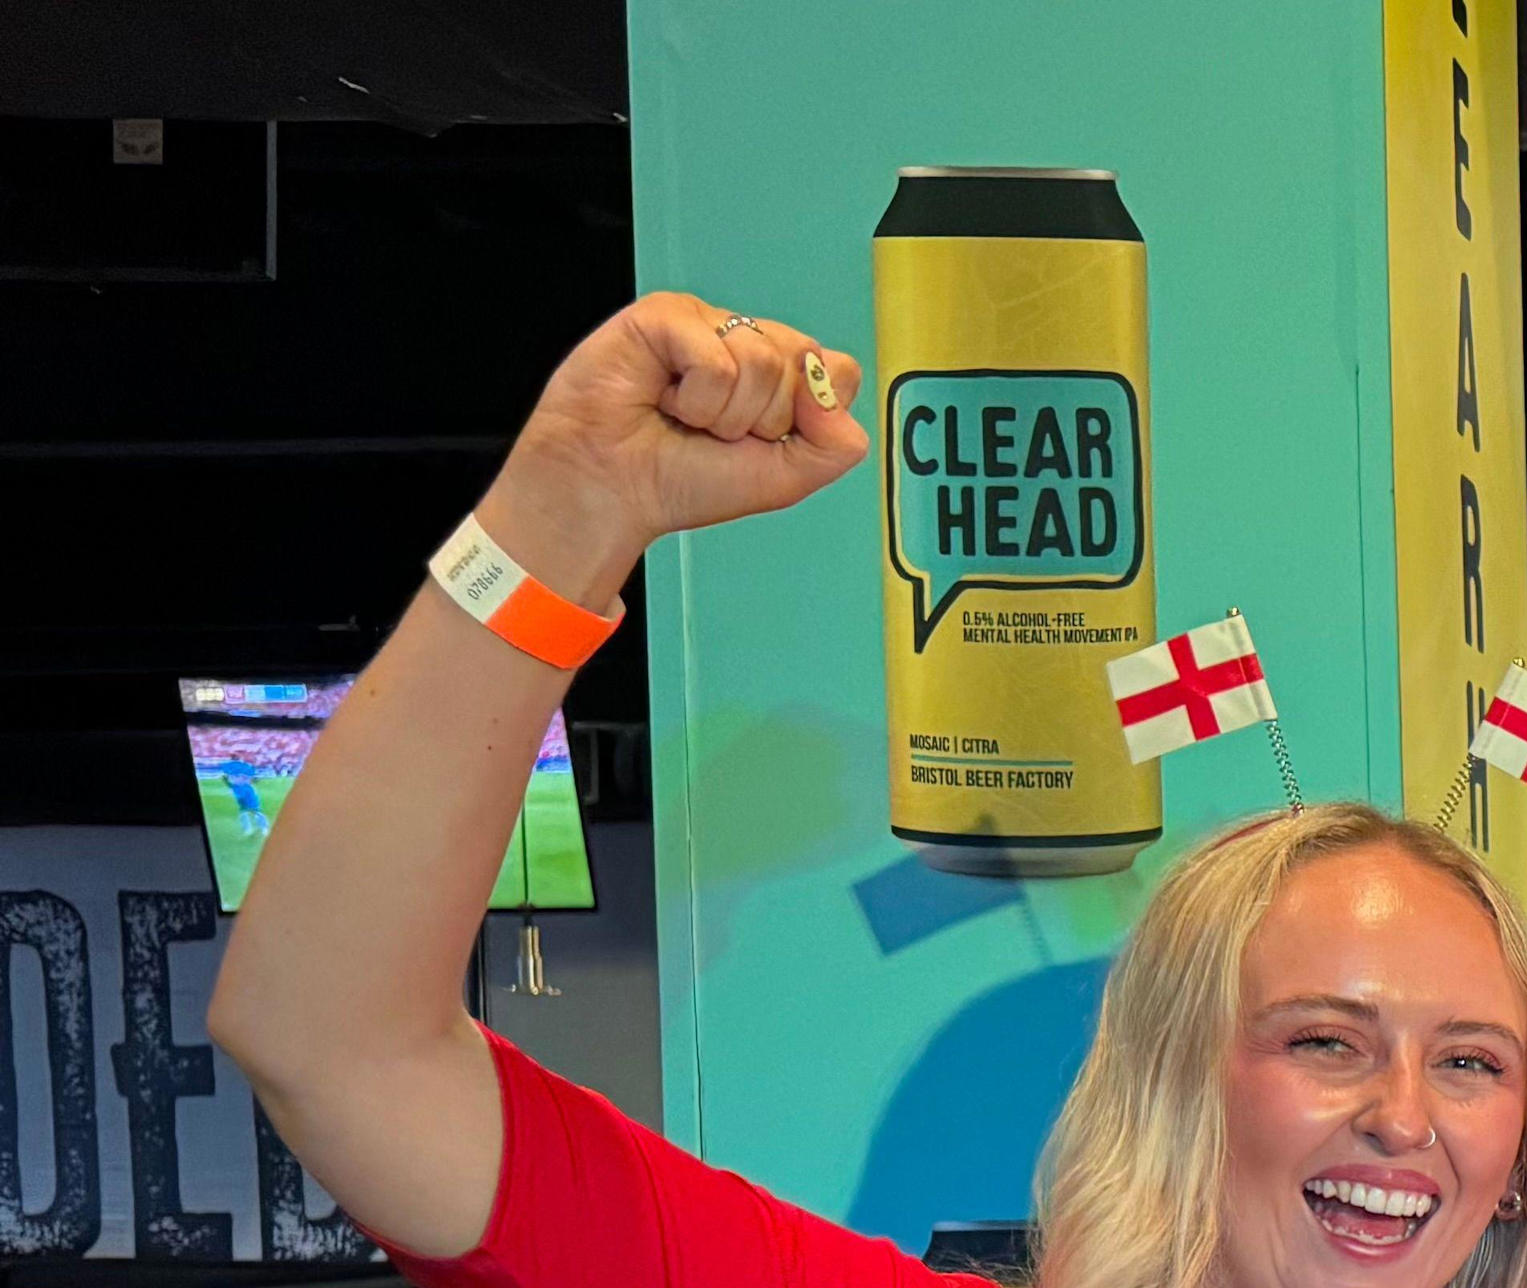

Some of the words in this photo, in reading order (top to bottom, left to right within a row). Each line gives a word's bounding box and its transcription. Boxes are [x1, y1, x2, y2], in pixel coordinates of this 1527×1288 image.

[903, 405, 1113, 479] CLEAR
[937, 485, 1118, 557] HEAD
[963, 610, 993, 626] 0.5%
[997, 612, 1085, 627] ALCOHOL-FREE
[963, 628, 1011, 643] MENTAL
[1014, 628, 1060, 644] HEALTH
[1063, 627, 1122, 643] MOVEMENT
[1125, 627, 1138, 641] IPA
[910, 734, 950, 753] MOSAIC
[962, 737, 999, 754] CITRA
[911, 765, 962, 786] BRISTOL
[966, 769, 1003, 788] BEER
[1008, 770, 1074, 789] FACTORY
